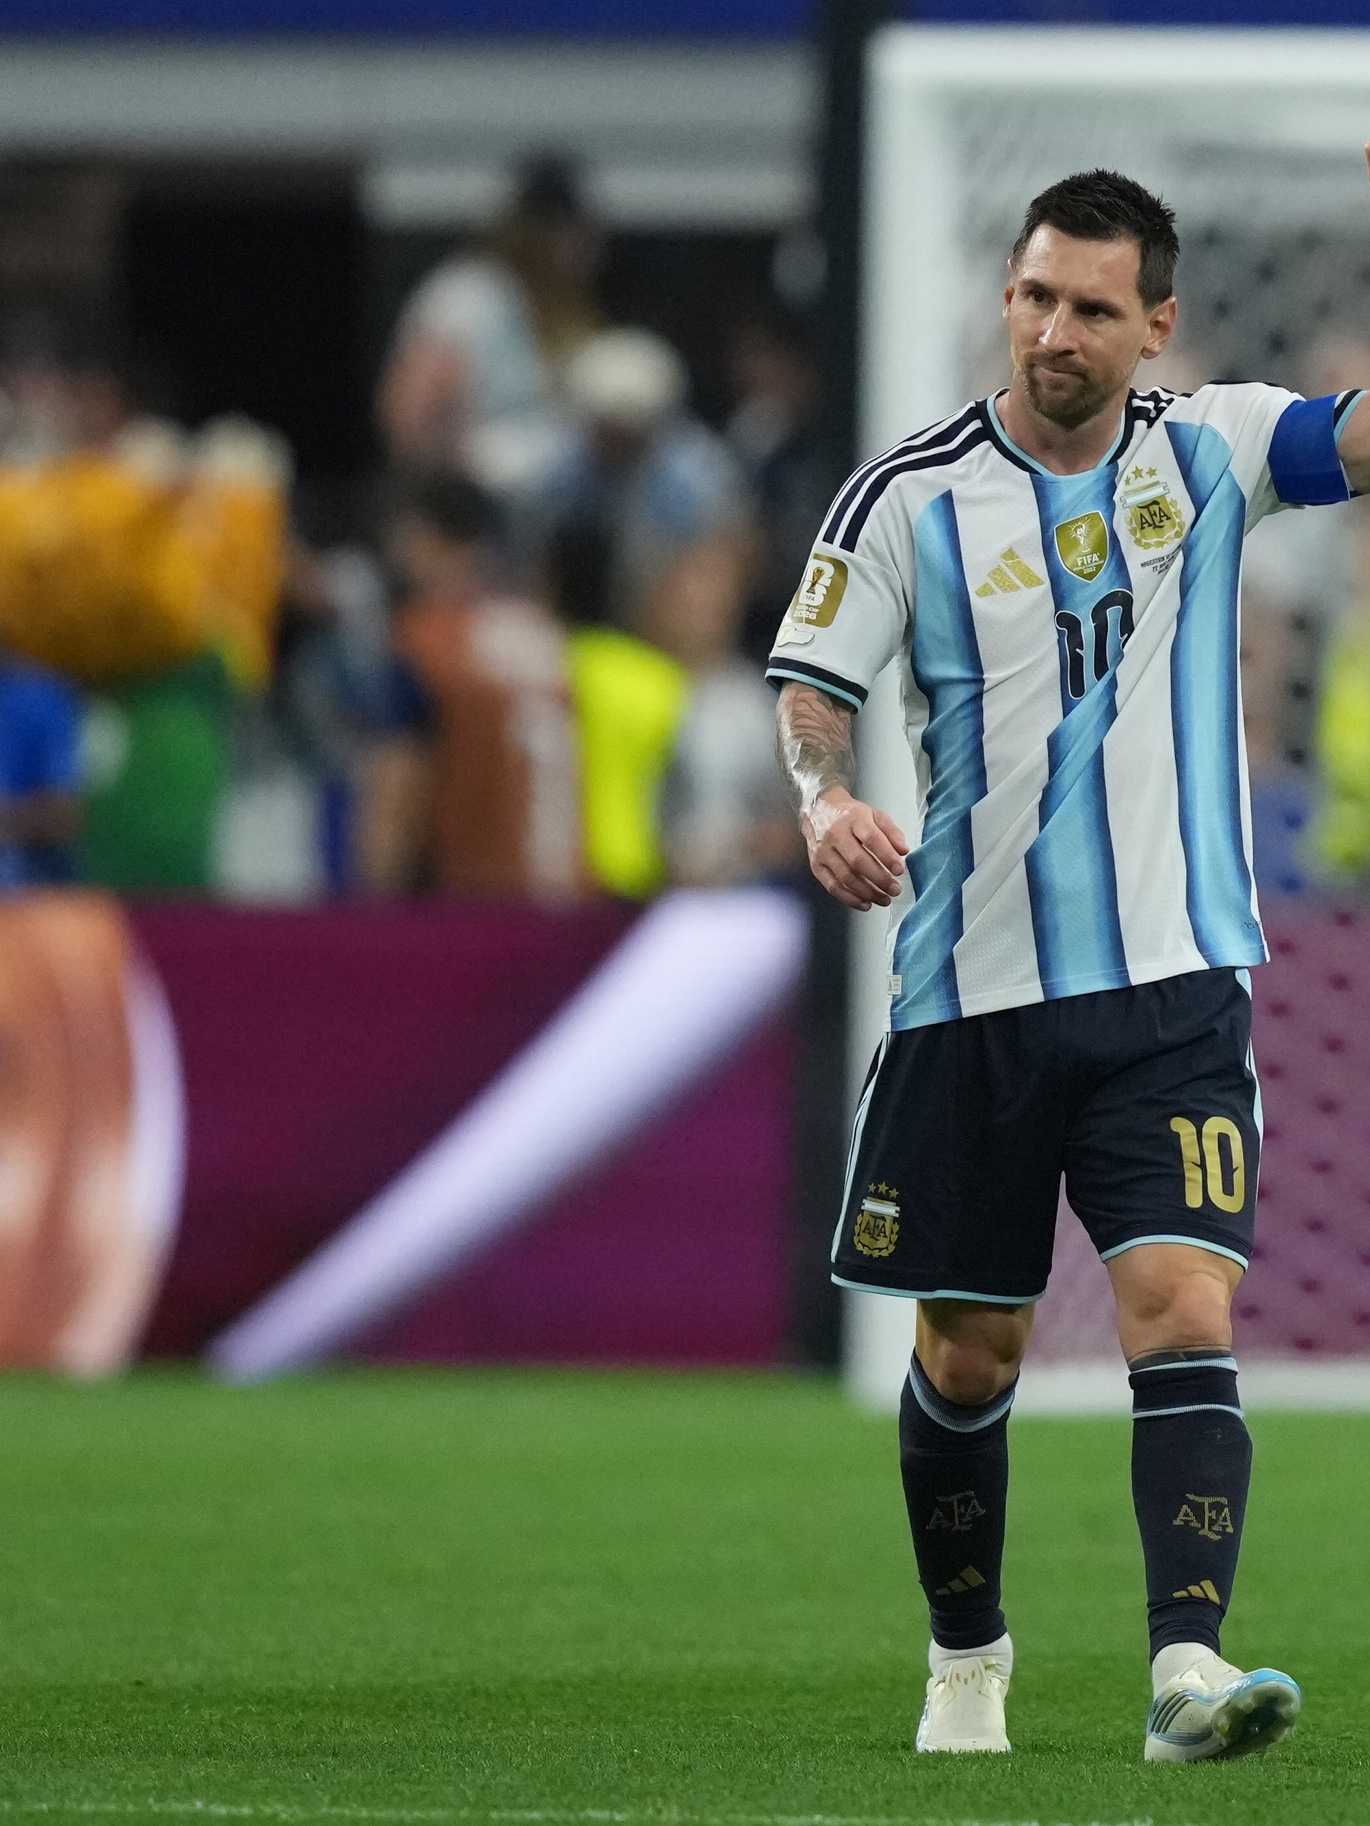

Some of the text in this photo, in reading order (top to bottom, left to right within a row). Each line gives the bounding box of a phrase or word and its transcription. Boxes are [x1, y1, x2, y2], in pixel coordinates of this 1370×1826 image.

[1137, 500, 1171, 530] AFA
[1077, 553, 1099, 567] FIFA
[793, 610, 817, 620] 2026
[1055, 588, 1135, 700] 10
[1169, 1116, 1245, 1213] 10
[862, 1213, 888, 1241] AFA
[926, 1490, 985, 1532] AFA
[1173, 1493, 1234, 1541] AFA
